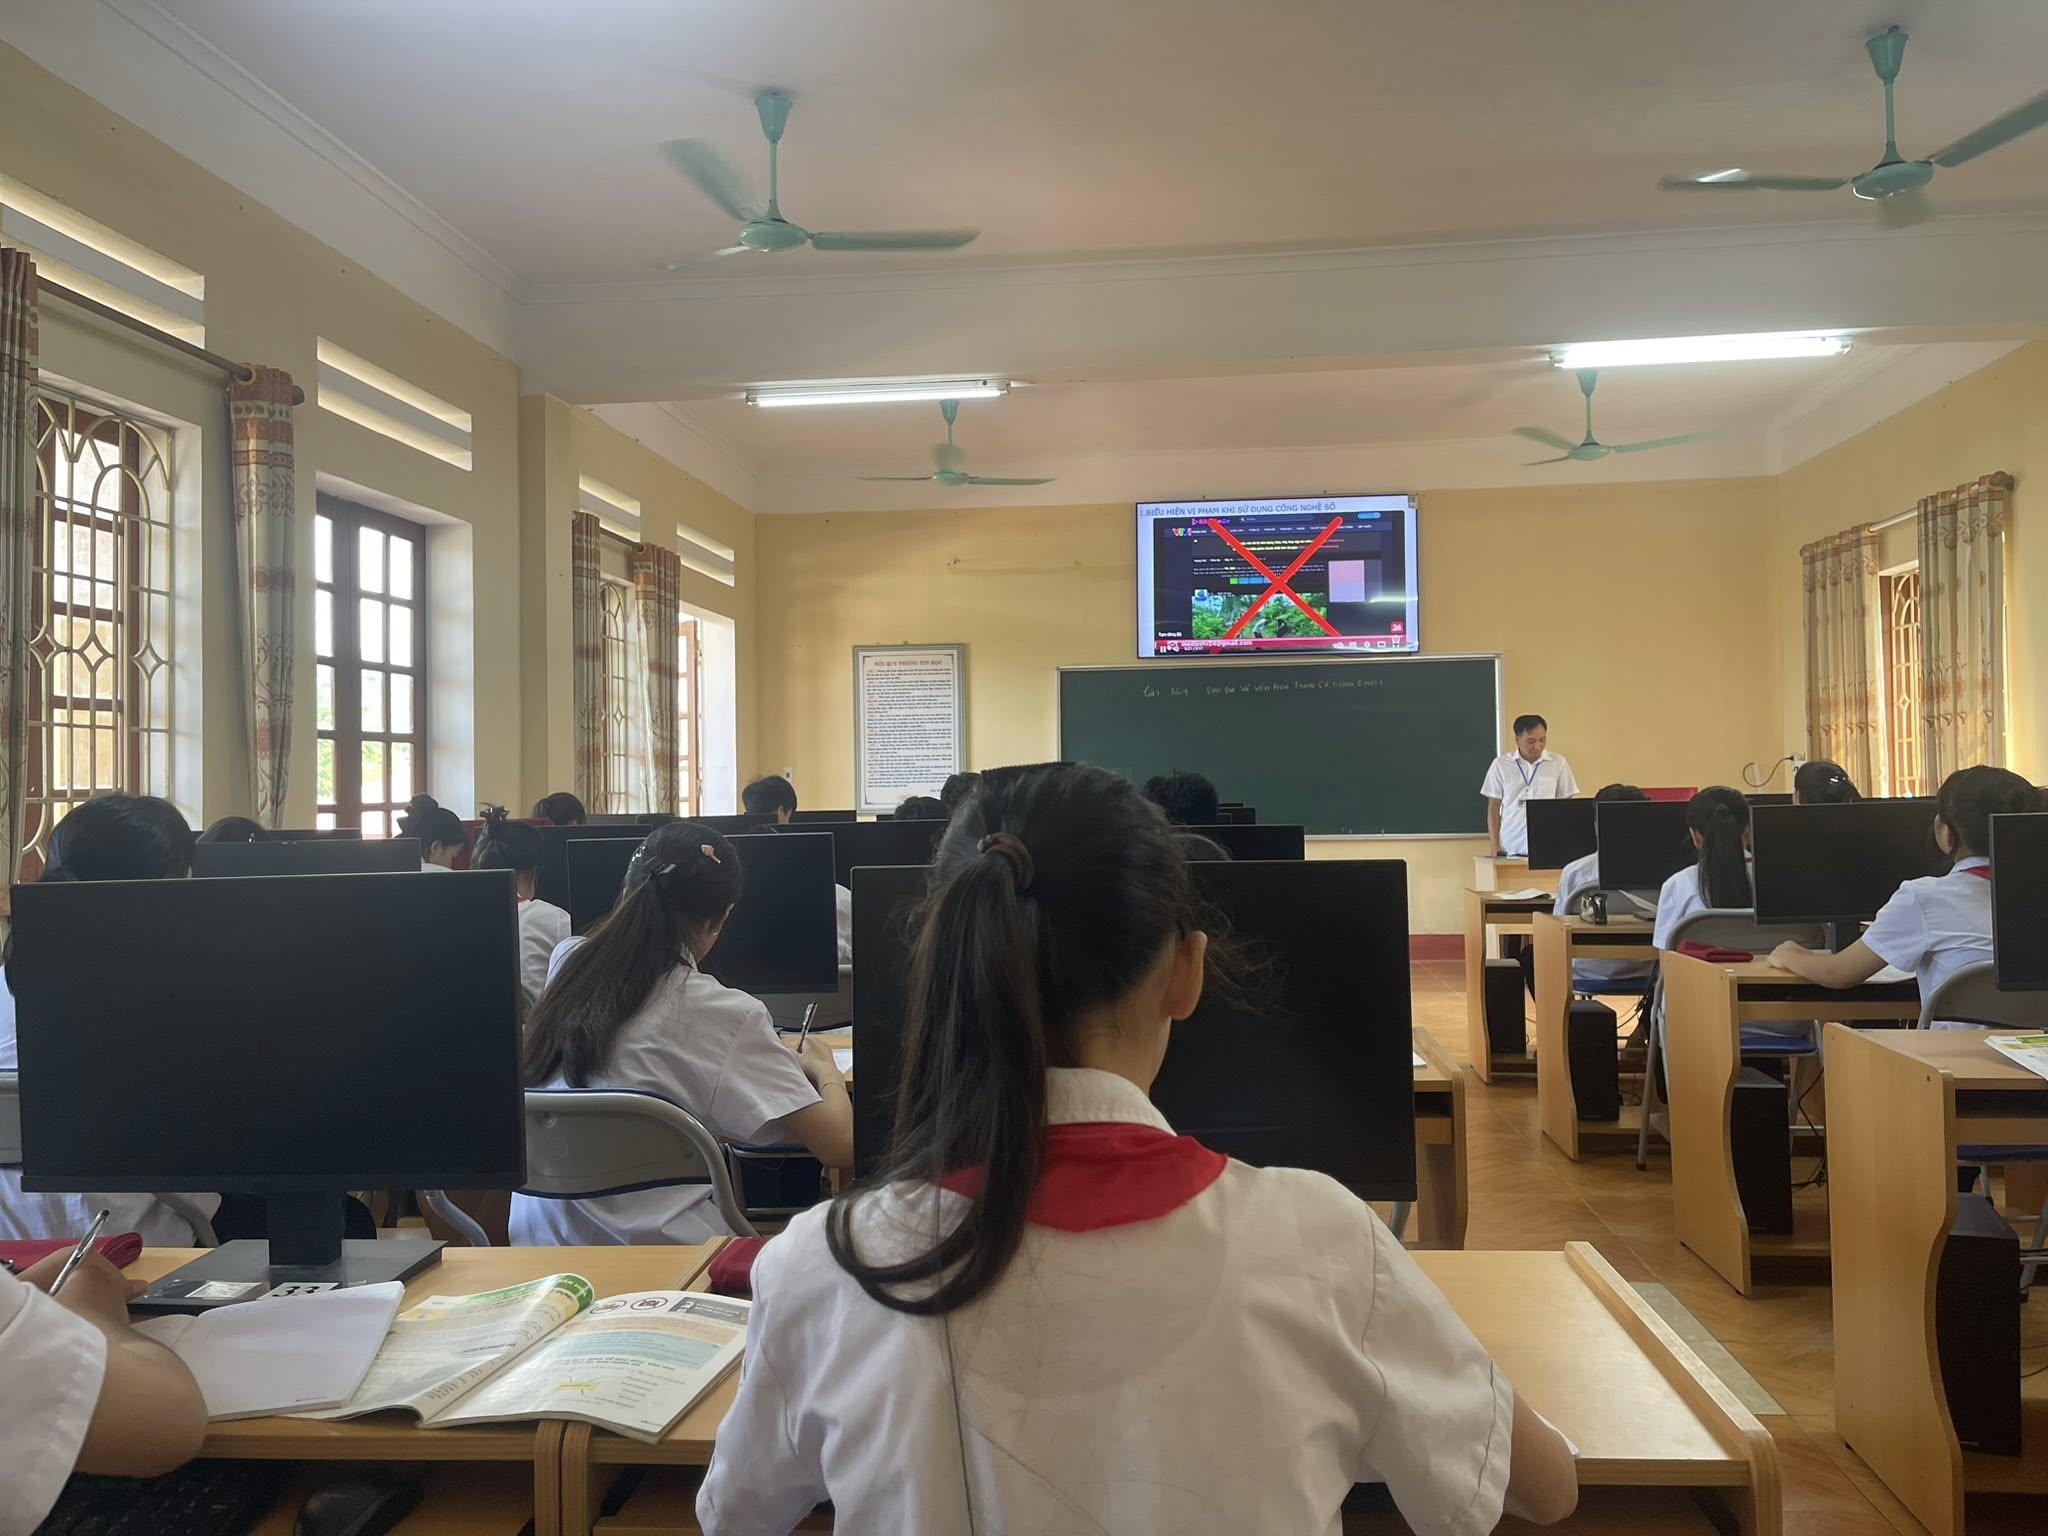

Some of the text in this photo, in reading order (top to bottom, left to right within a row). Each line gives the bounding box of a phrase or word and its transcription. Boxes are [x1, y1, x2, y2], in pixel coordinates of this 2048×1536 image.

[1166, 506, 1186, 516] HIỆN
[1221, 505, 1236, 514] KHI
[1275, 503, 1298, 513] CÔNG
